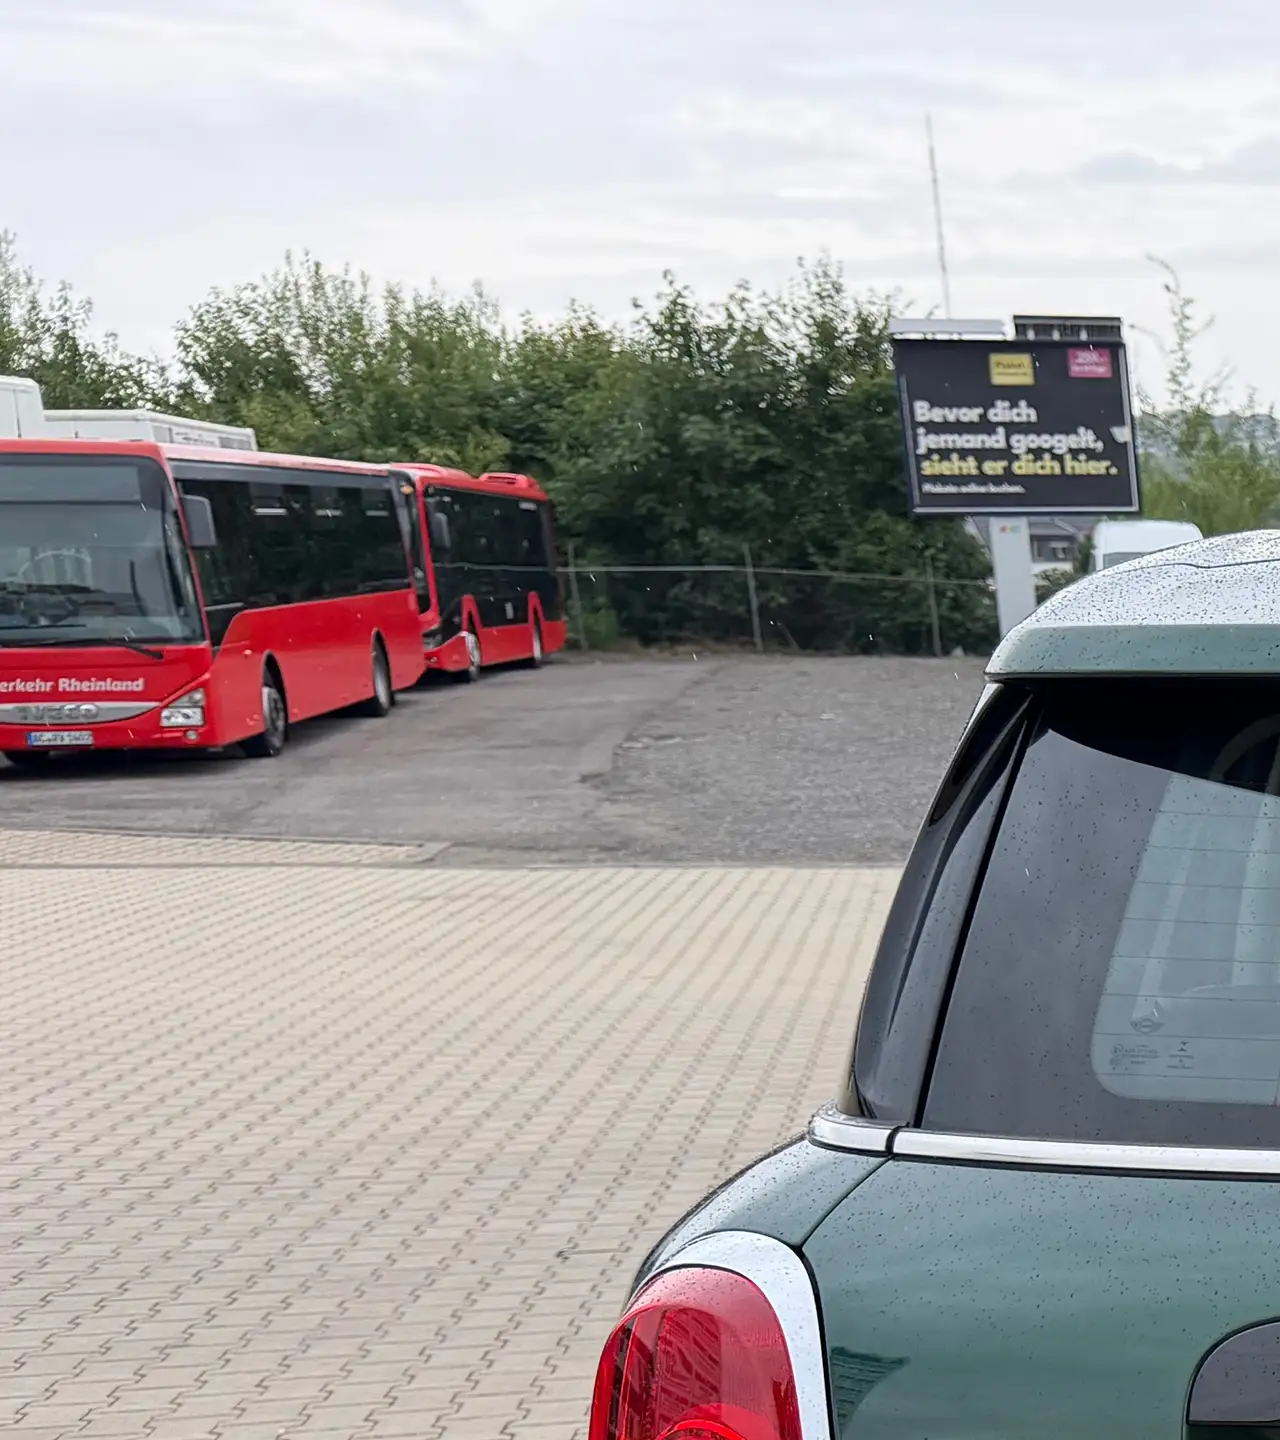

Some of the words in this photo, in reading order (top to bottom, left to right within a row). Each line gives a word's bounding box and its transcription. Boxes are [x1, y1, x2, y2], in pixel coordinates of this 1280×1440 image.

[913, 400, 984, 422] Bevor
[986, 400, 1038, 422] dich
[916, 426, 1007, 454] jemand
[1009, 426, 1104, 454] googelt,
[920, 453, 979, 475] sieht
[981, 459, 1008, 475] er
[1011, 453, 1061, 475] dich
[1063, 453, 1118, 475] hier.
[58, 678, 145, 692] Rheinland
